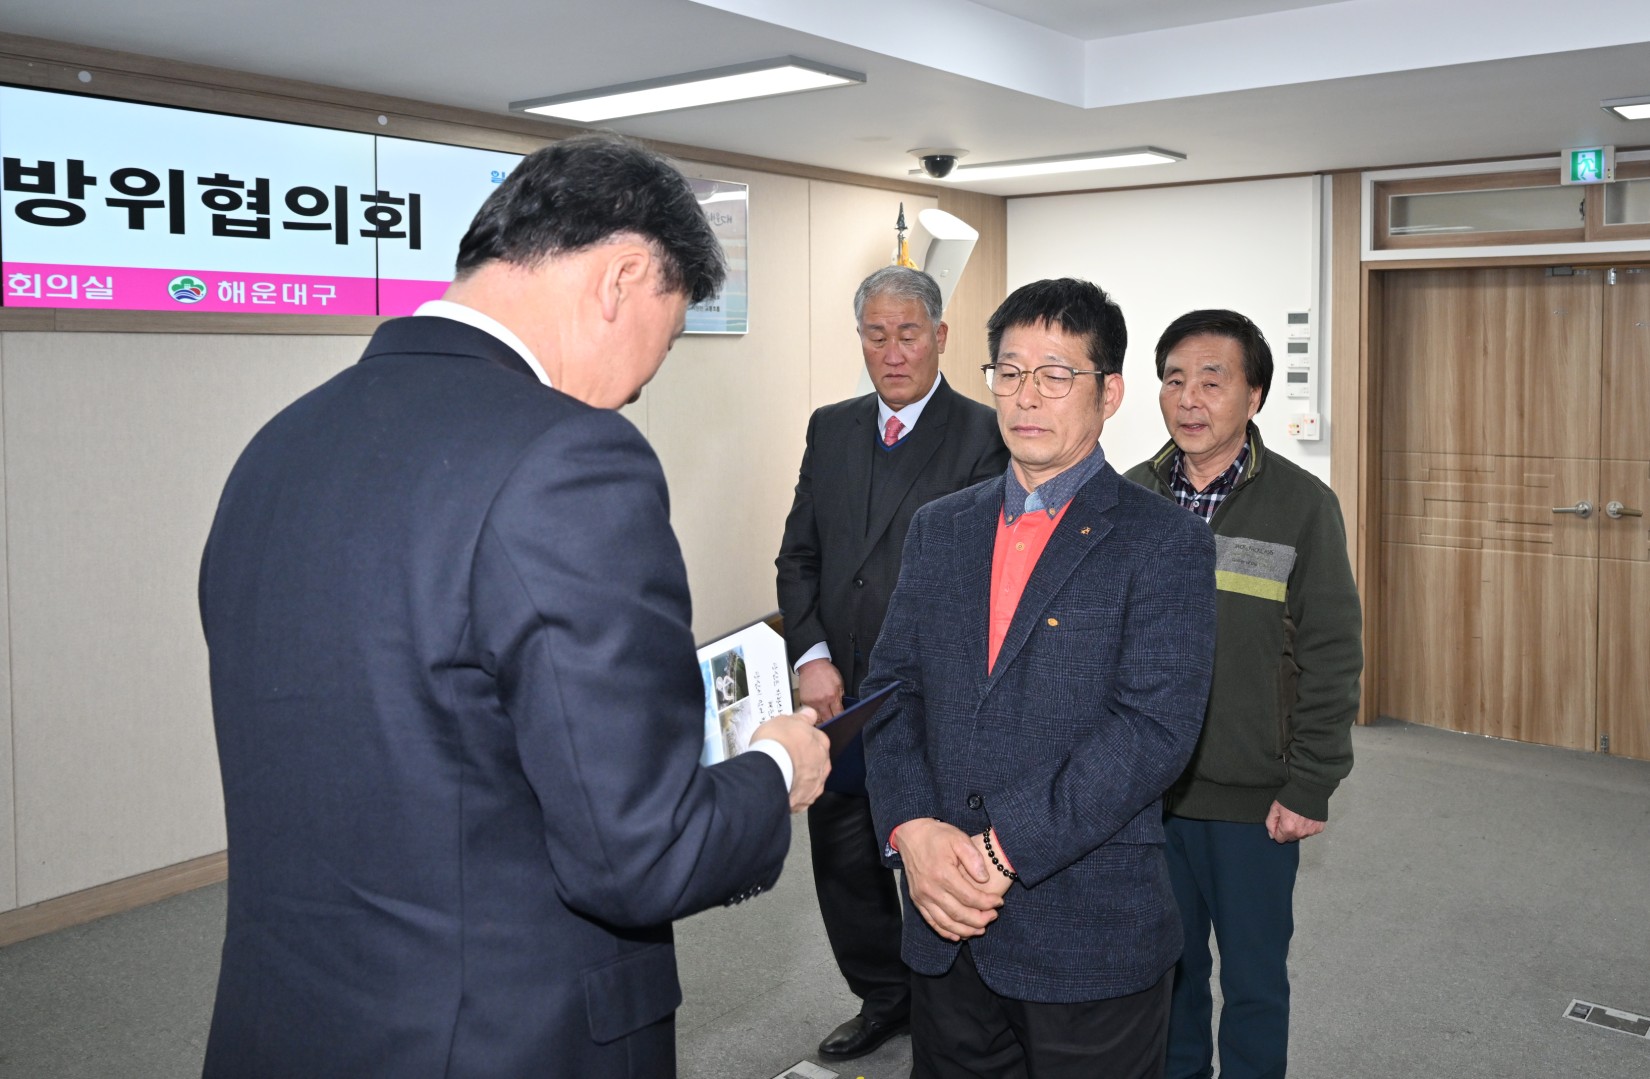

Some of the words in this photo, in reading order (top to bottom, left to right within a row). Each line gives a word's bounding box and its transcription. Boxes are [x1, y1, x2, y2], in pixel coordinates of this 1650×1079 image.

[3, 157, 421, 250] 방위협의회
[8, 273, 113, 300] 회의실
[217, 281, 337, 306] 해운대구
